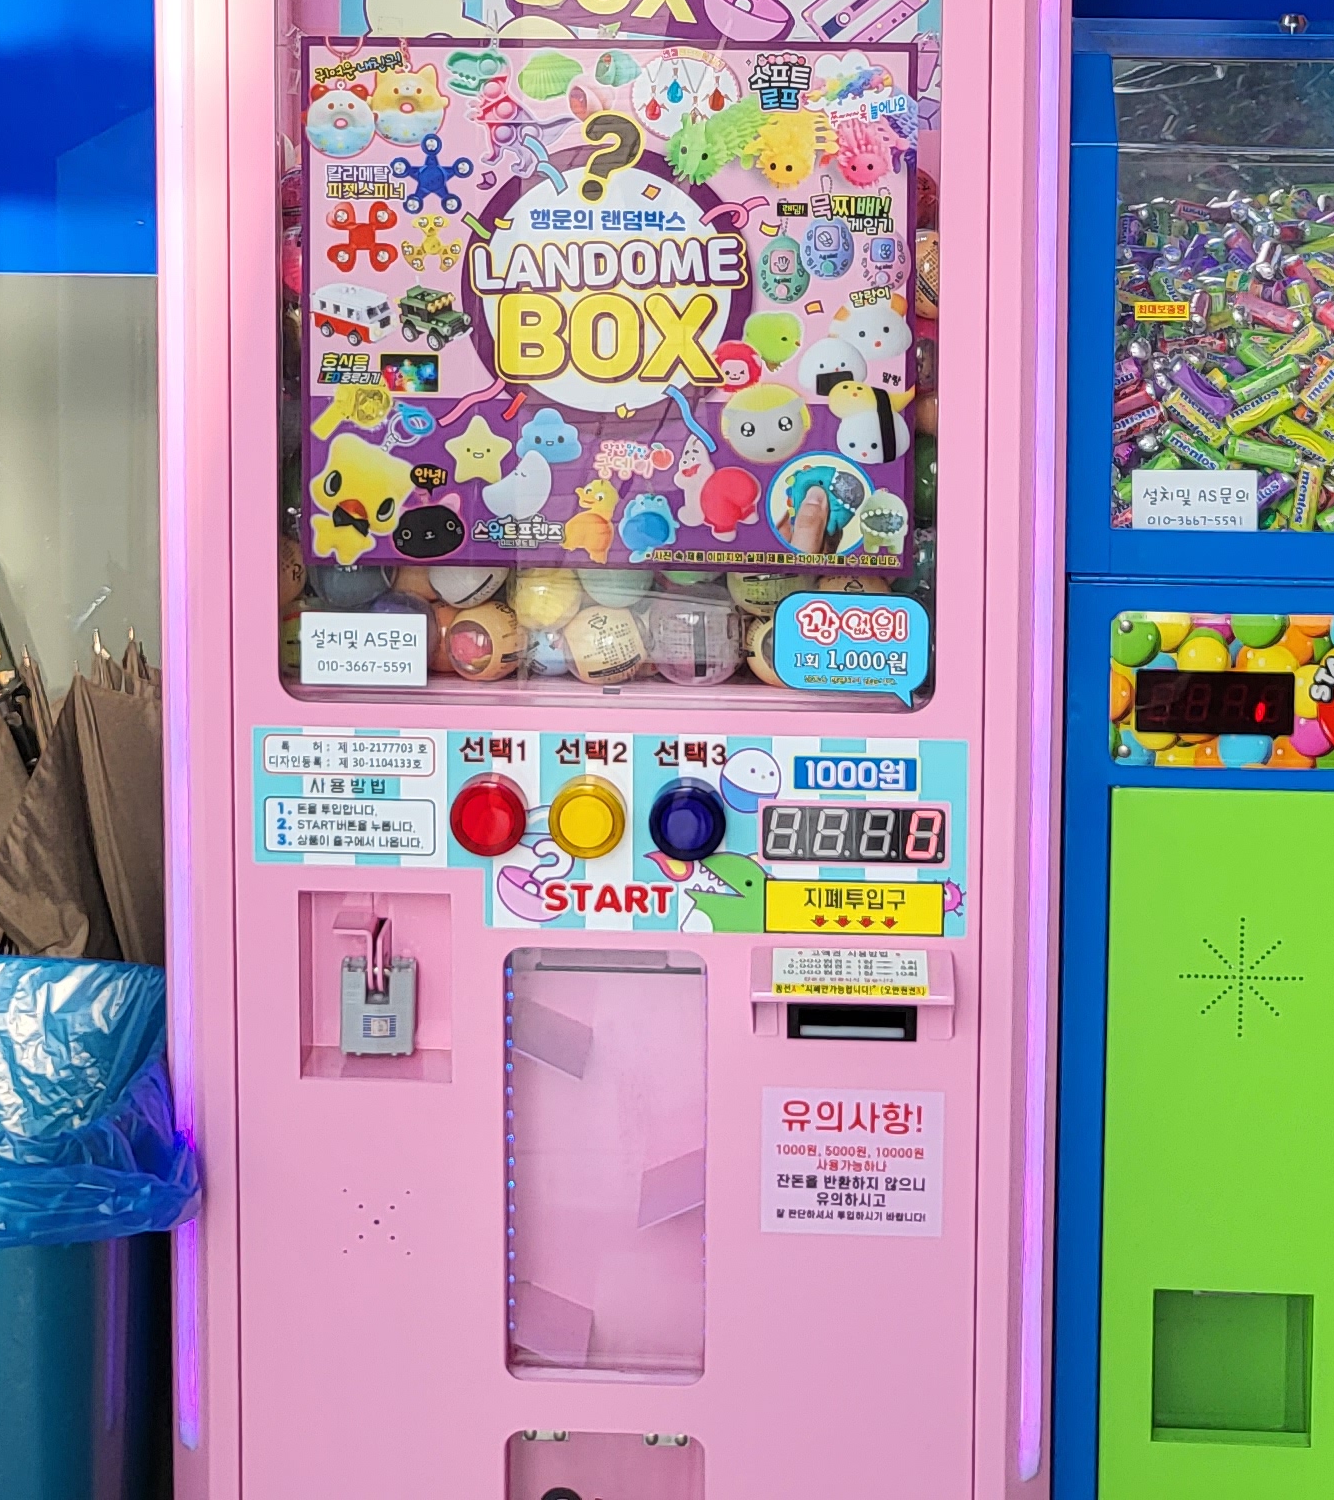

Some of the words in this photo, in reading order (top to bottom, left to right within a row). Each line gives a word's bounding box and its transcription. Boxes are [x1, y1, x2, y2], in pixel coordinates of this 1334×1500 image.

[327, 165, 390, 182] 칼라메탈
[327, 182, 405, 200] 피젯스피너
[530, 209, 594, 231] 행운의
[601, 209, 686, 232] 랜덤박스
[848, 217, 893, 235] 게임기
[472, 238, 743, 294] LANDOME
[499, 292, 725, 384] BOX
[1229, 389, 1280, 418] mentos
[1170, 435, 1217, 470] mentos
[414, 467, 447, 484] 안녕!
[1143, 486, 1192, 507] 설치및
[1198, 486, 1250, 505] AS문의
[1295, 470, 1310, 524] mentos
[1147, 515, 1243, 526] 010-3667-5591
[311, 629, 359, 650] 설치및
[363, 629, 417, 650] AS문의
[317, 660, 412, 675] 010-3667-5591
[827, 650, 909, 675] 1,000원
[459, 736, 527, 764] 선택1
[555, 738, 628, 766] 선택2
[654, 740, 727, 768] 선택3
[805, 759, 907, 790] 1000원
[309, 778, 386, 794] 사용방법
[277, 802, 293, 815] 1.
[276, 818, 293, 830] 2.
[276, 834, 293, 846] 3.
[545, 882, 674, 914] START
[804, 887, 907, 912] 지폐투입구
[782, 1100, 923, 1135] 유의사항!
[816, 1160, 887, 1173] 사용가능하나
[776, 1174, 818, 1189] 잔돈을
[823, 1175, 879, 1191] 반환하지
[884, 1177, 926, 1192] 않으니
[816, 1192, 886, 1208] 유의하시고
